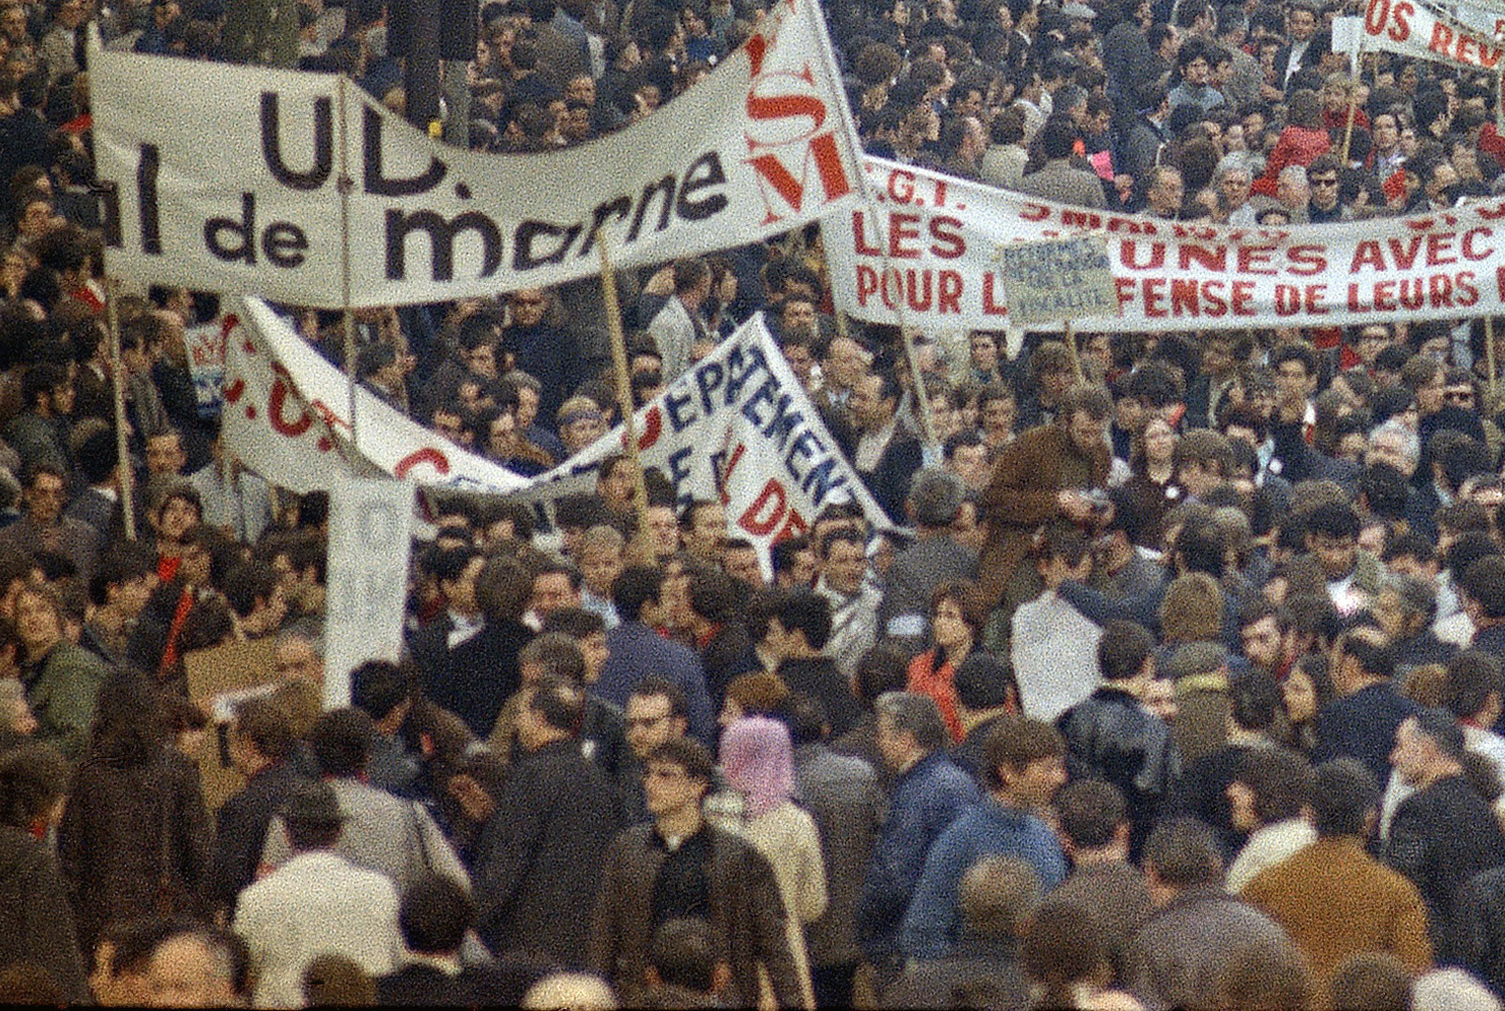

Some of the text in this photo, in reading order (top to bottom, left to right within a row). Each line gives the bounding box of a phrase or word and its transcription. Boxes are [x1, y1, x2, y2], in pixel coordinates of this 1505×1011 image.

[203, 191, 309, 268] de
[385, 149, 727, 282] marne
[852, 210, 967, 259] LES
[1350, 225, 1505, 273] AVEC
[855, 264, 964, 315] POUR
[1273, 279, 1331, 317] DE
[1346, 270, 1480, 314] LEURS
